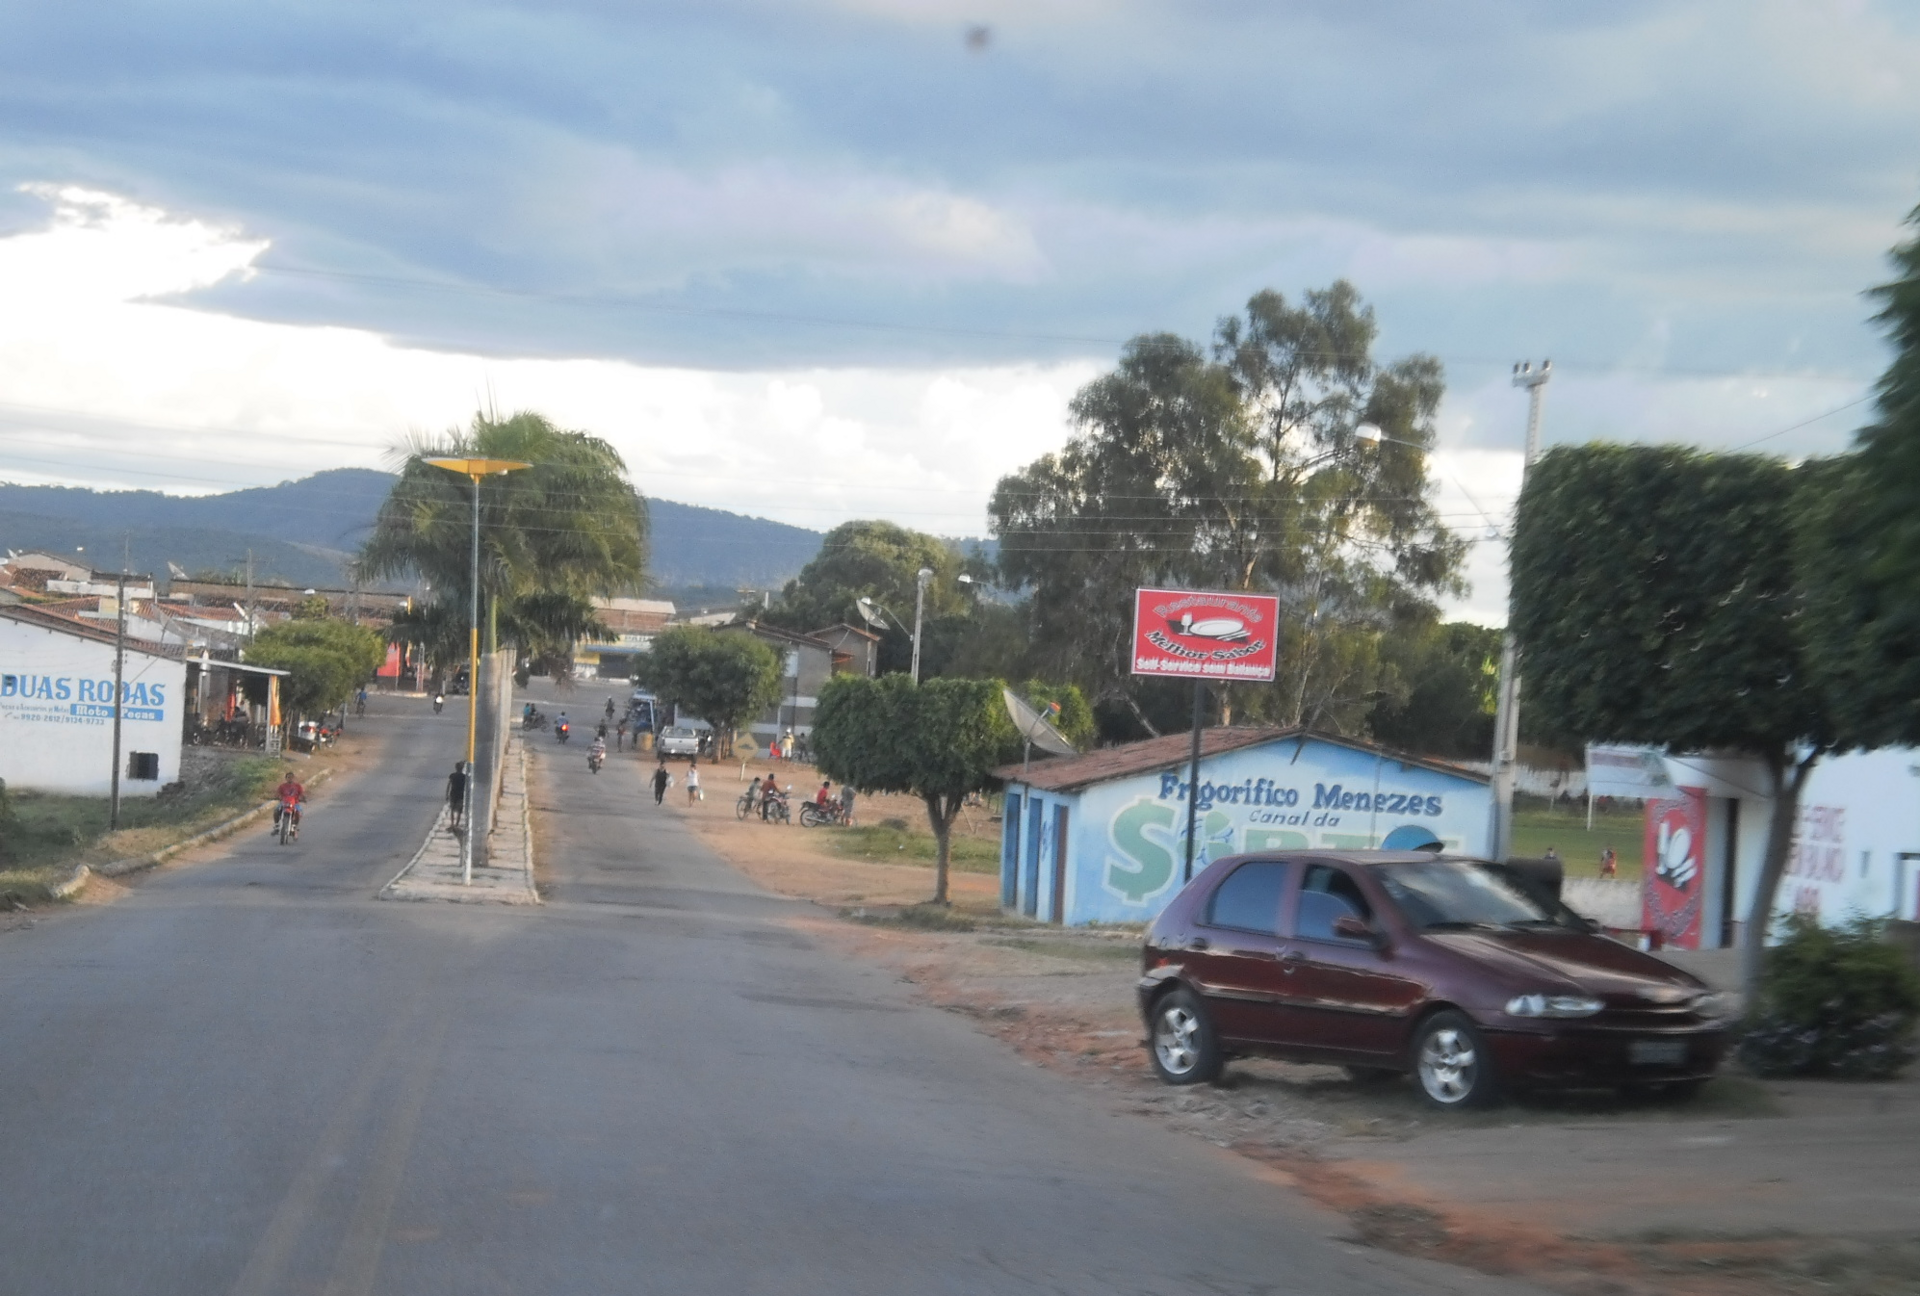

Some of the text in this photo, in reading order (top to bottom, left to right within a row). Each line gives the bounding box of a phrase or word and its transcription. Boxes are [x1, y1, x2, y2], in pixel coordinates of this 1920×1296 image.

[1153, 595, 1263, 623] Restaurante
[1144, 629, 1267, 661] Melhor Sabor
[1, 673, 71, 700] DUAS
[76, 705, 109, 717] Moto
[1159, 772, 1444, 817] Frgorifico Menezes
[1249, 809, 1341, 827] Canal da
